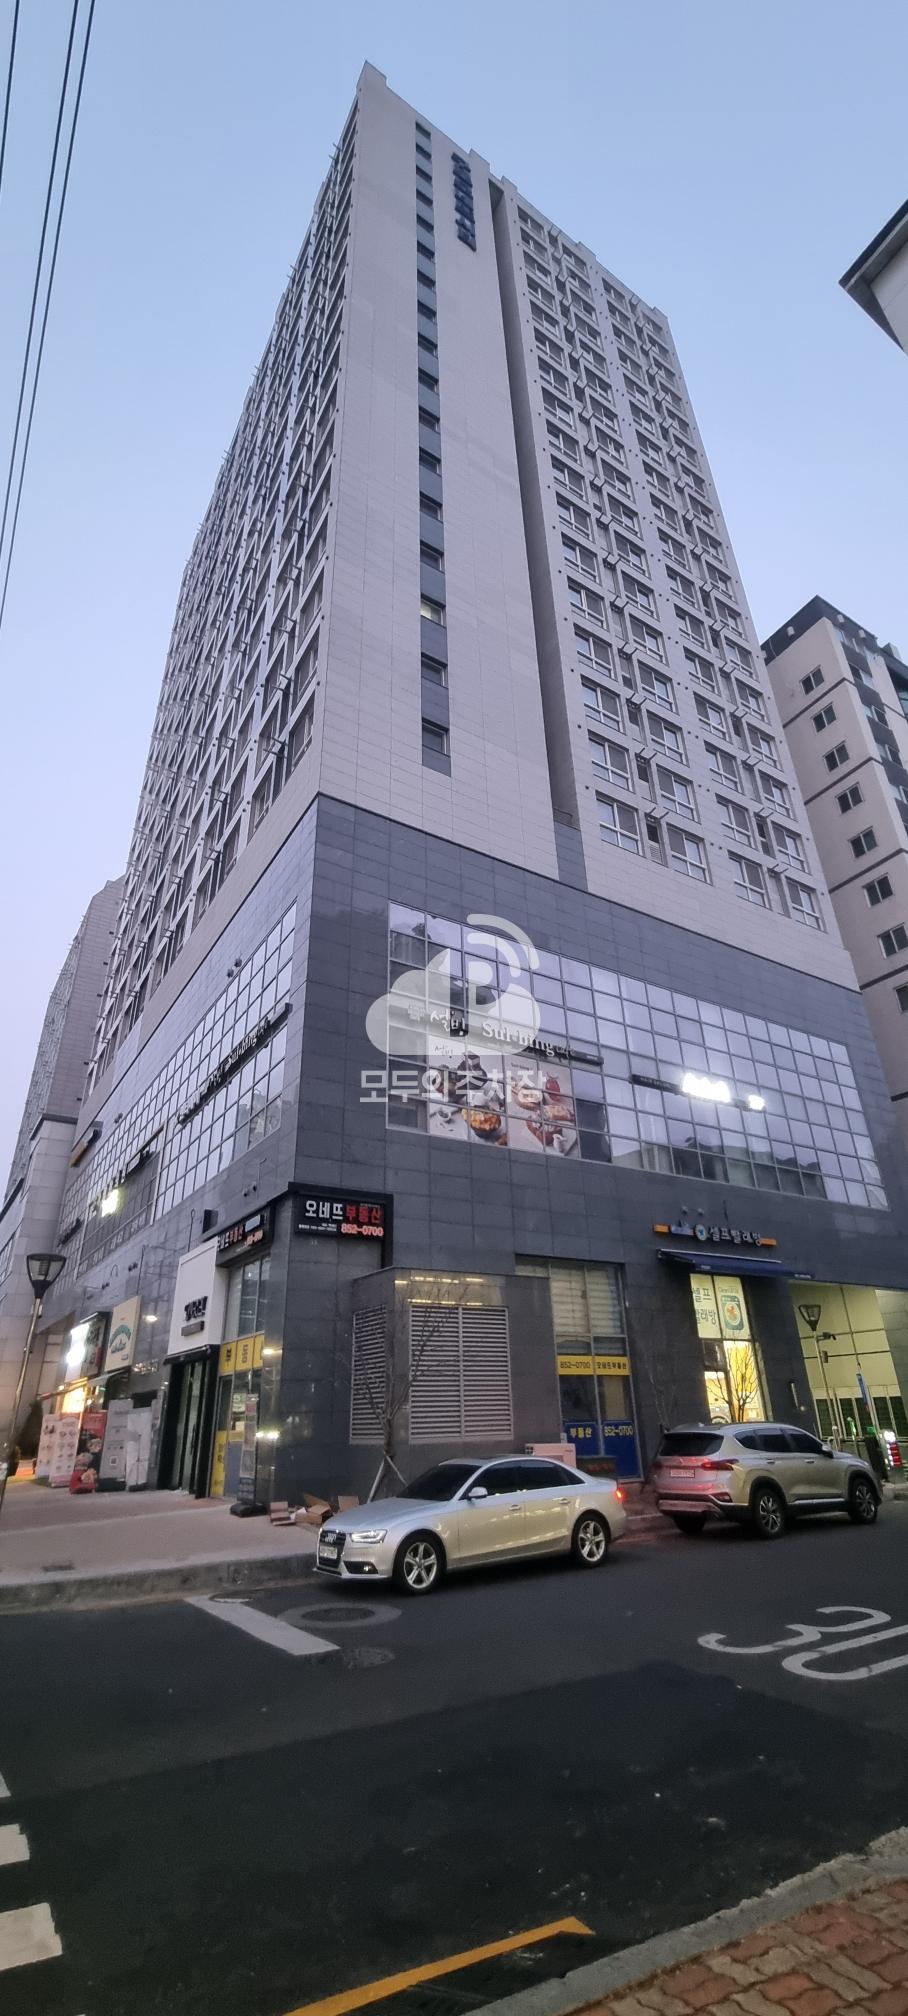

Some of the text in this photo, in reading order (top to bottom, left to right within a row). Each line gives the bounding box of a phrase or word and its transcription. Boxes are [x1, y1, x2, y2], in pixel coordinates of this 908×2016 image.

[305, 1200, 382, 1224] 오네뜨부동산
[341, 1223, 384, 1236] 852-0700
[697, 1606, 908, 1681] 30
